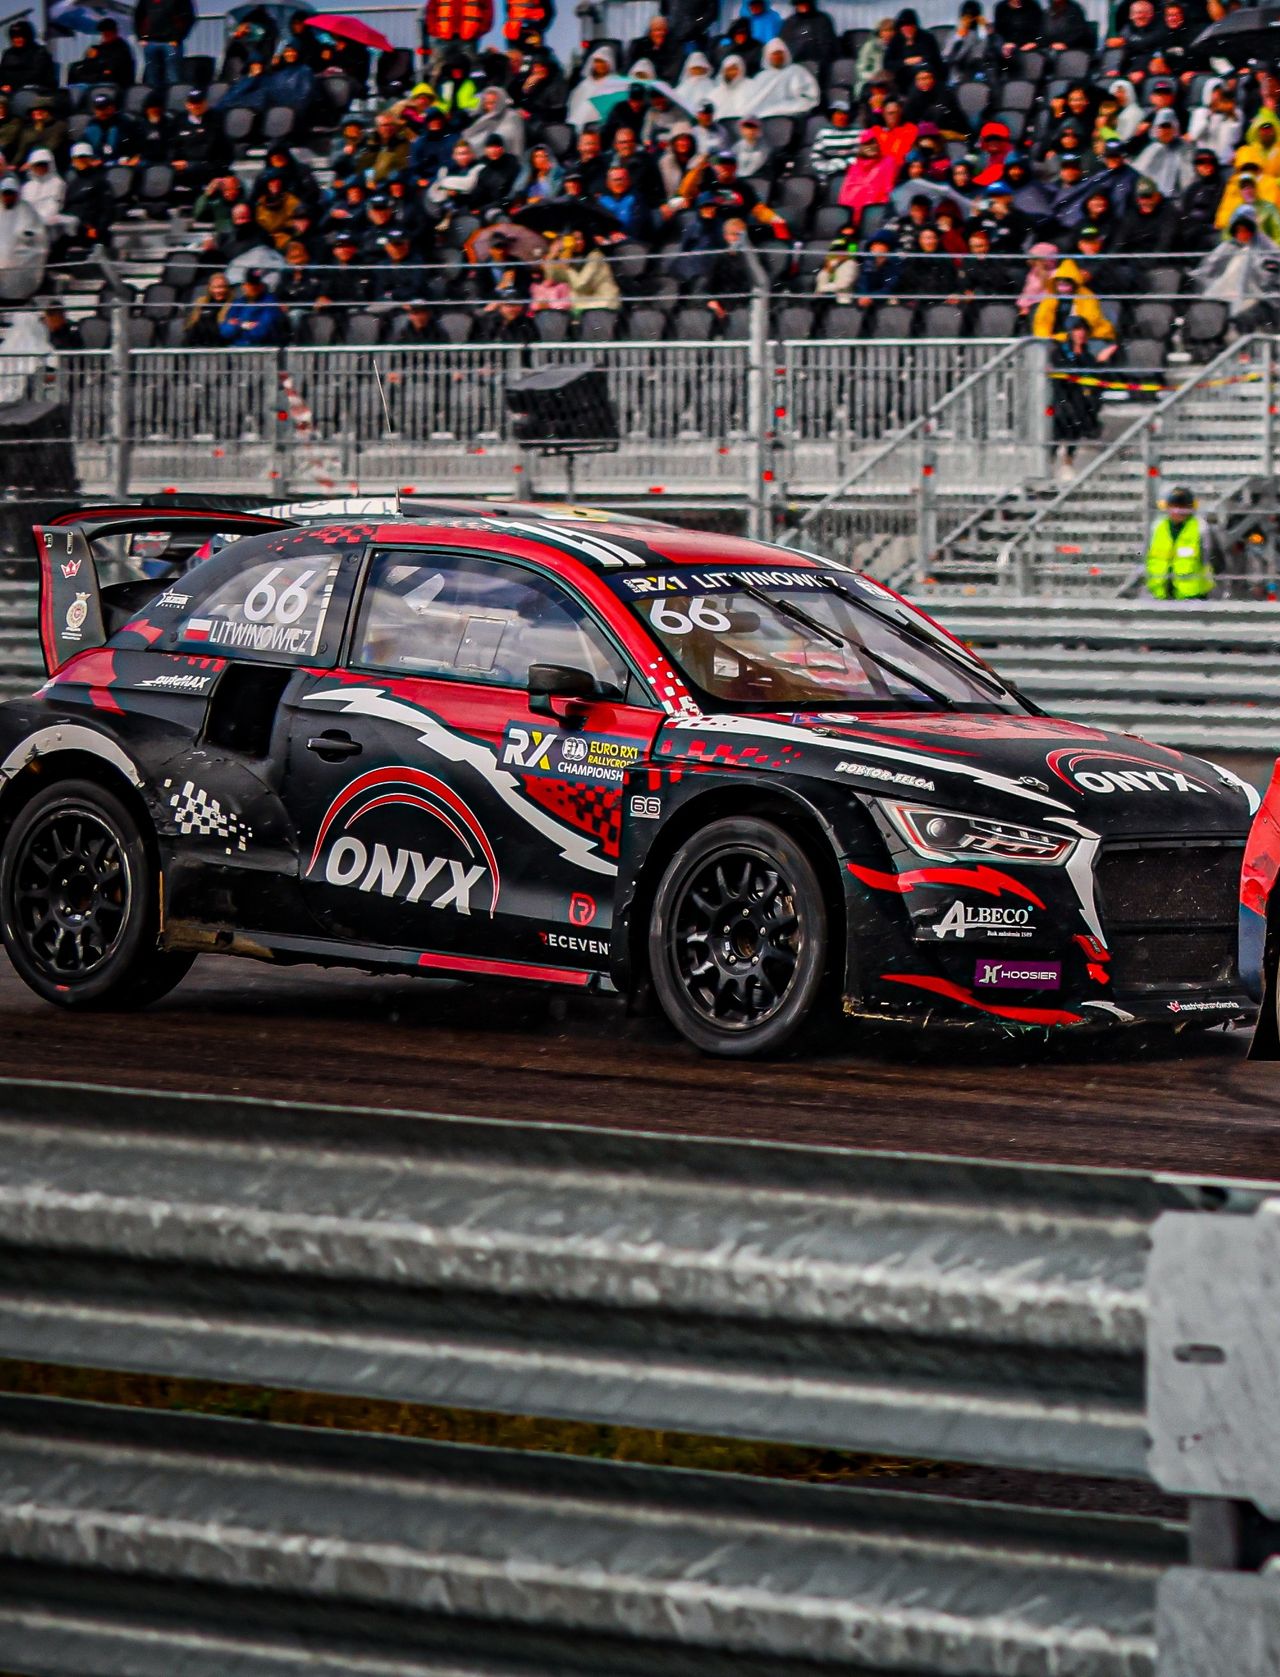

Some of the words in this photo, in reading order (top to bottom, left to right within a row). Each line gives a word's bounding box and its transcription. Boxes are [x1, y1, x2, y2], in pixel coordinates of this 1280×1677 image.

[243, 566, 317, 624] 66
[649, 598, 732, 635] 66
[208, 619, 313, 653] LITWINOWICZ
[502, 728, 559, 770] RX
[587, 754, 635, 769] RALLYCRO
[590, 740, 619, 757] EURO
[619, 743, 639, 760] RX1
[1074, 769, 1207, 794] ONYX
[630, 796, 661, 817] 66
[325, 836, 487, 916] ONYX
[932, 900, 1031, 939] ALBECO
[1001, 970, 1058, 981] HOOSIER
